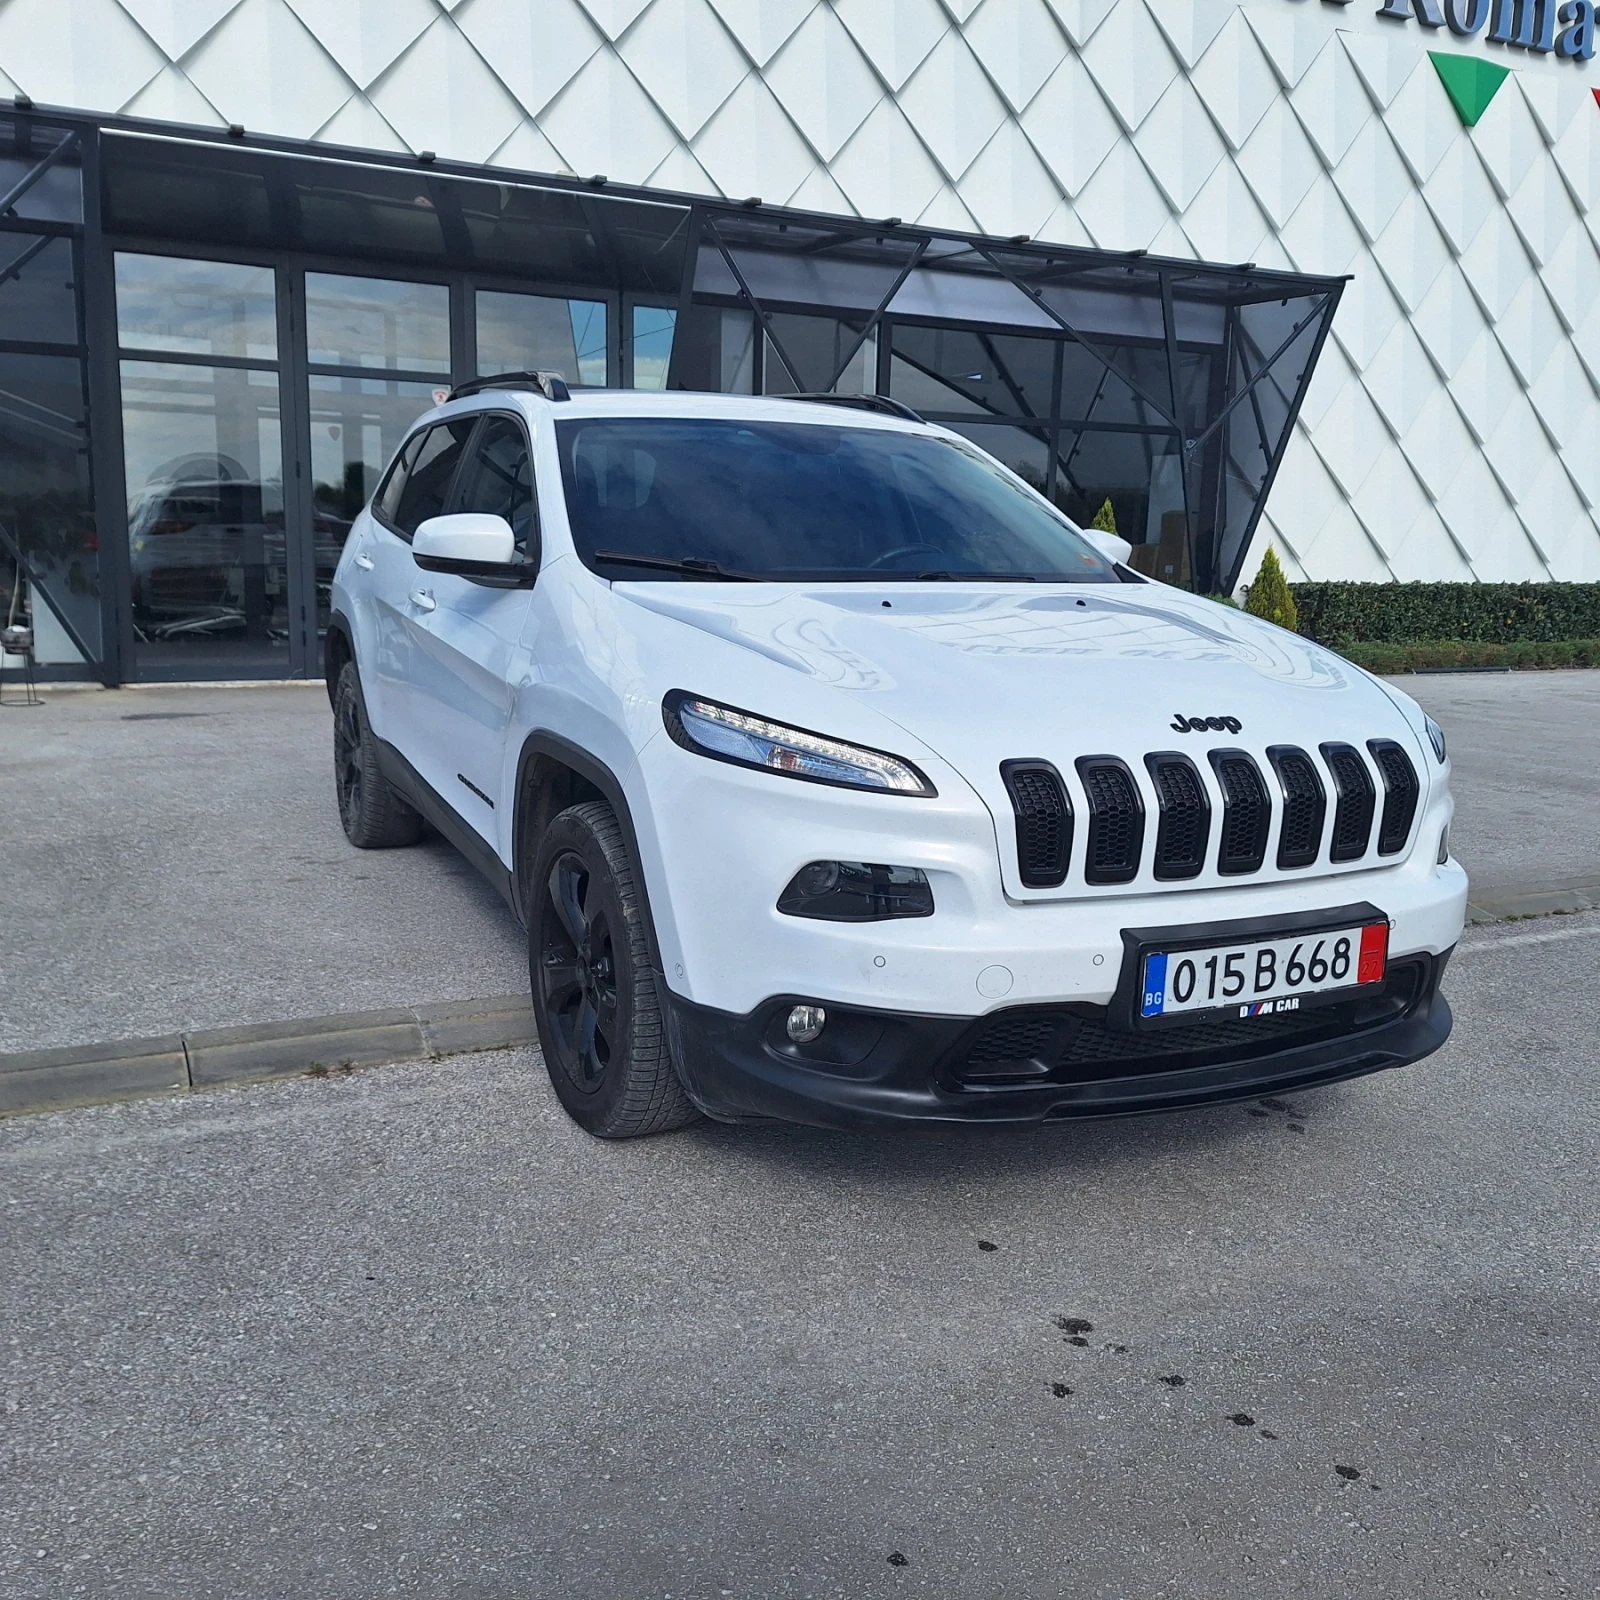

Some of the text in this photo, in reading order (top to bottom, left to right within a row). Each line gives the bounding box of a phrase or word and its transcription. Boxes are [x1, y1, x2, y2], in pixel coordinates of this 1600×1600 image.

[1169, 713, 1243, 734] Jeep
[1145, 991, 1162, 1006] BG
[1276, 998, 1299, 1012] CAR
